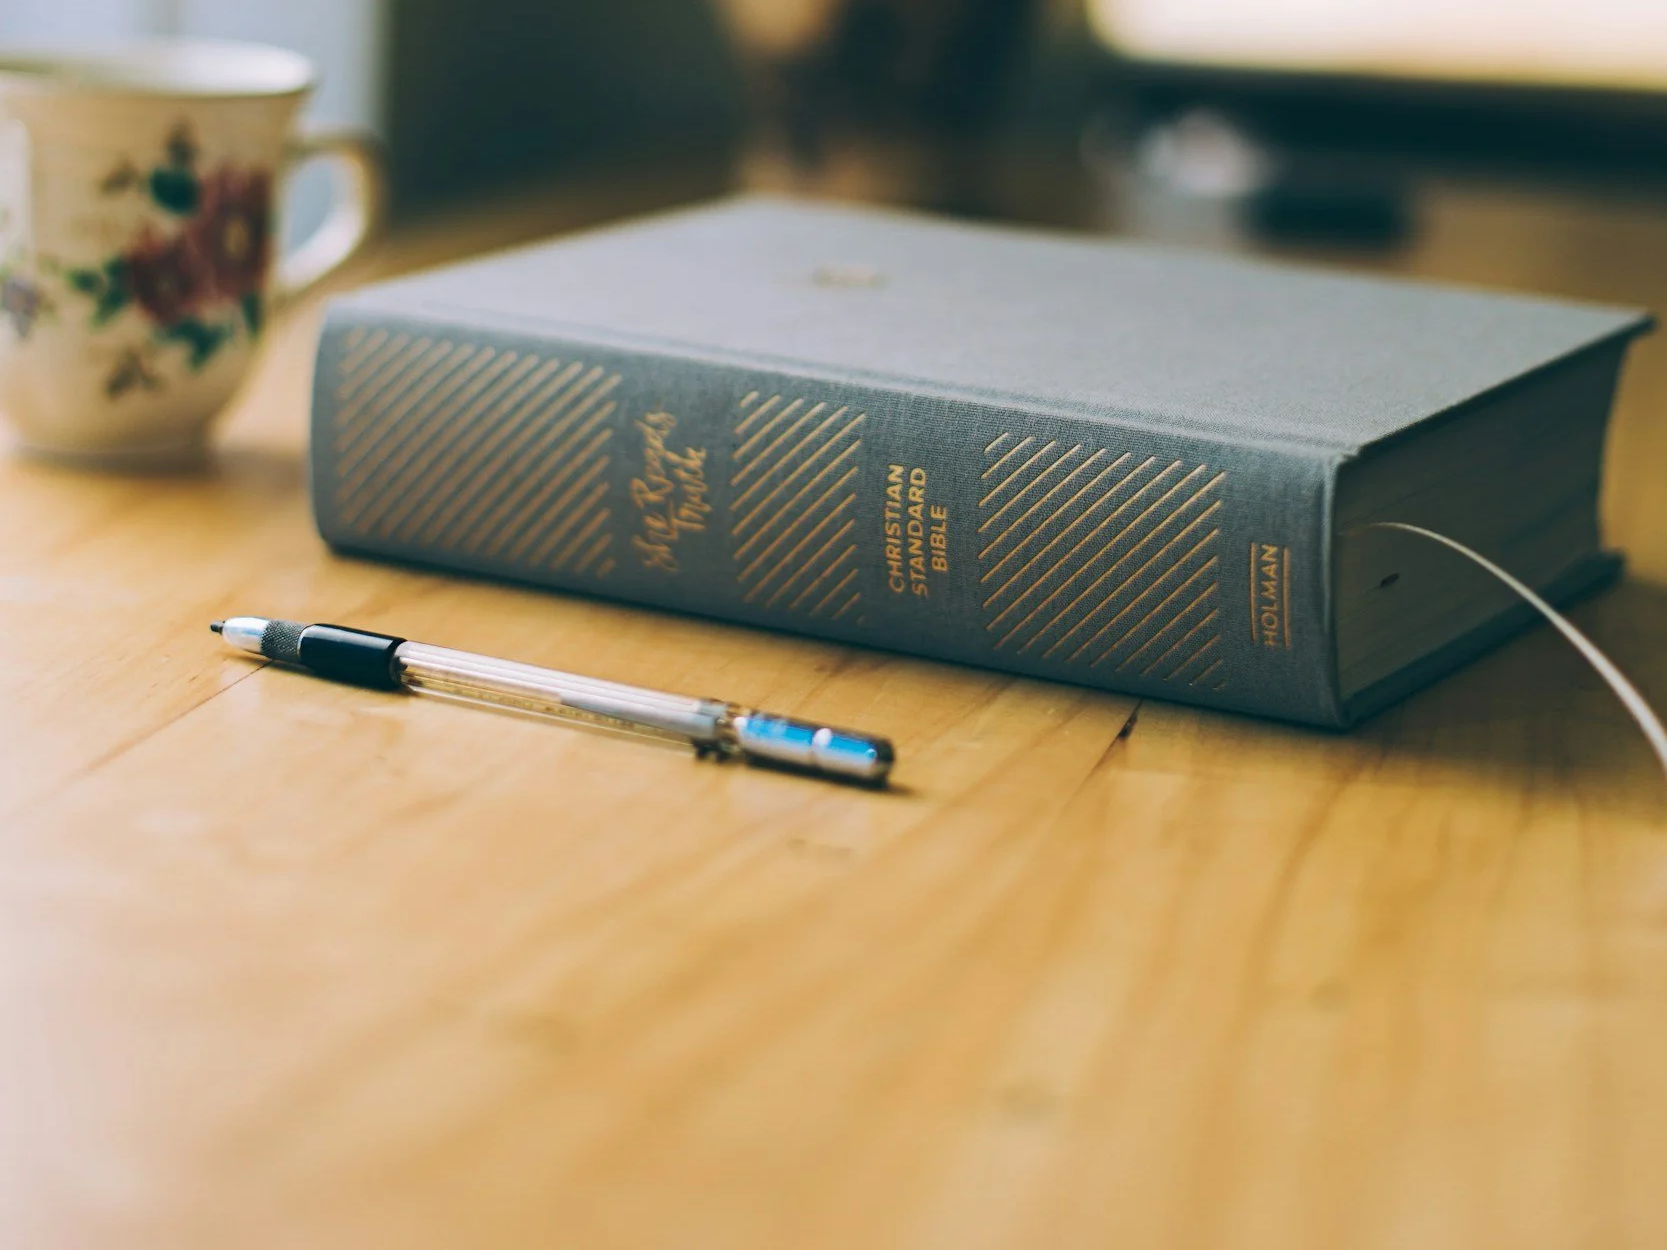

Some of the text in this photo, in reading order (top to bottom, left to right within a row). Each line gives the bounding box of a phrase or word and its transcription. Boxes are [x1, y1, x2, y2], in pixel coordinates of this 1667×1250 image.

[664, 446, 712, 539] Truth
[884, 464, 904, 593] CHRISTIAN
[907, 467, 927, 596] STANDARD
[930, 504, 948, 572] BIBLE
[632, 512, 677, 573] She
[1260, 543, 1278, 646] HOLMAN
